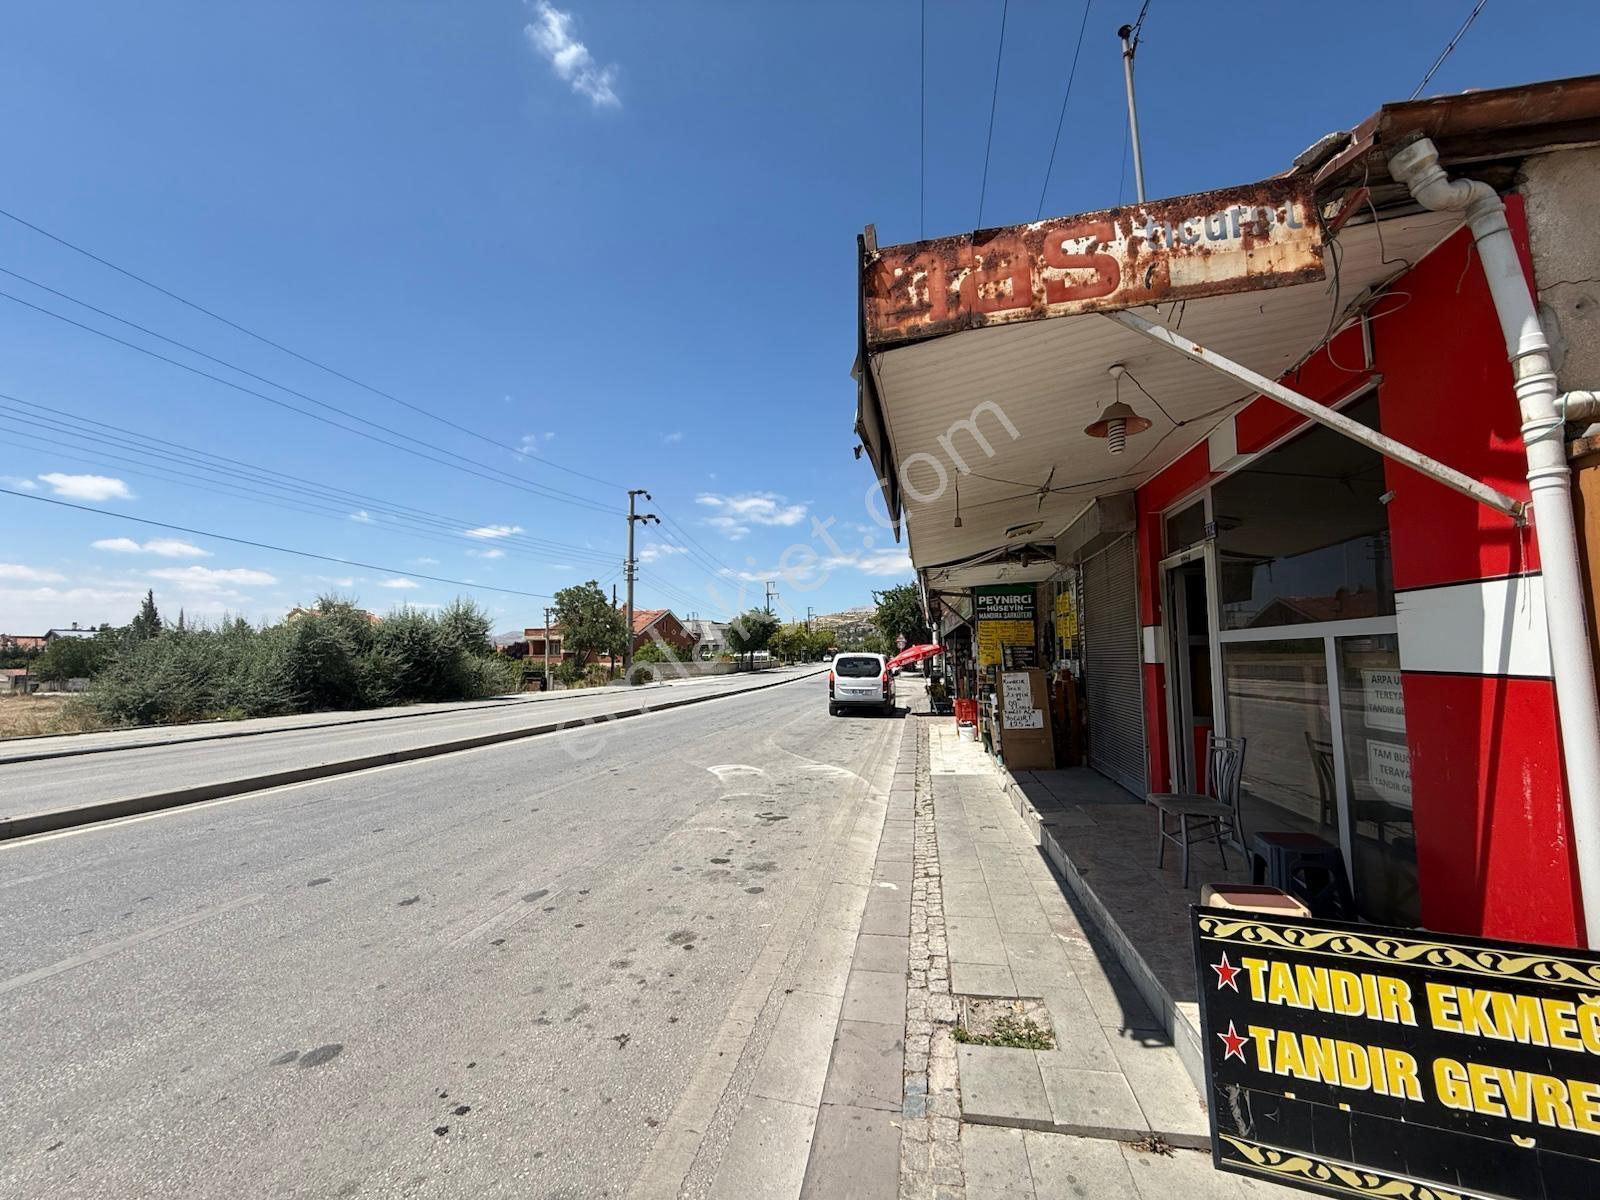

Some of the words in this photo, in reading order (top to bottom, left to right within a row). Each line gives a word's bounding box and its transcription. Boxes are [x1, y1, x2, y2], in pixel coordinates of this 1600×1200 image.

[986, 604, 1024, 612] HÜSEYİN
[1371, 674, 1392, 685] ARPA
[1369, 703, 1394, 714] TANDIR
[1373, 748, 1392, 761] TAM
[1374, 777, 1400, 791] TANDIR
[1241, 957, 1418, 1027] TANDIR
[1247, 1025, 1425, 1103] TANDIR
[1432, 1058, 1600, 1136] GEVRE
